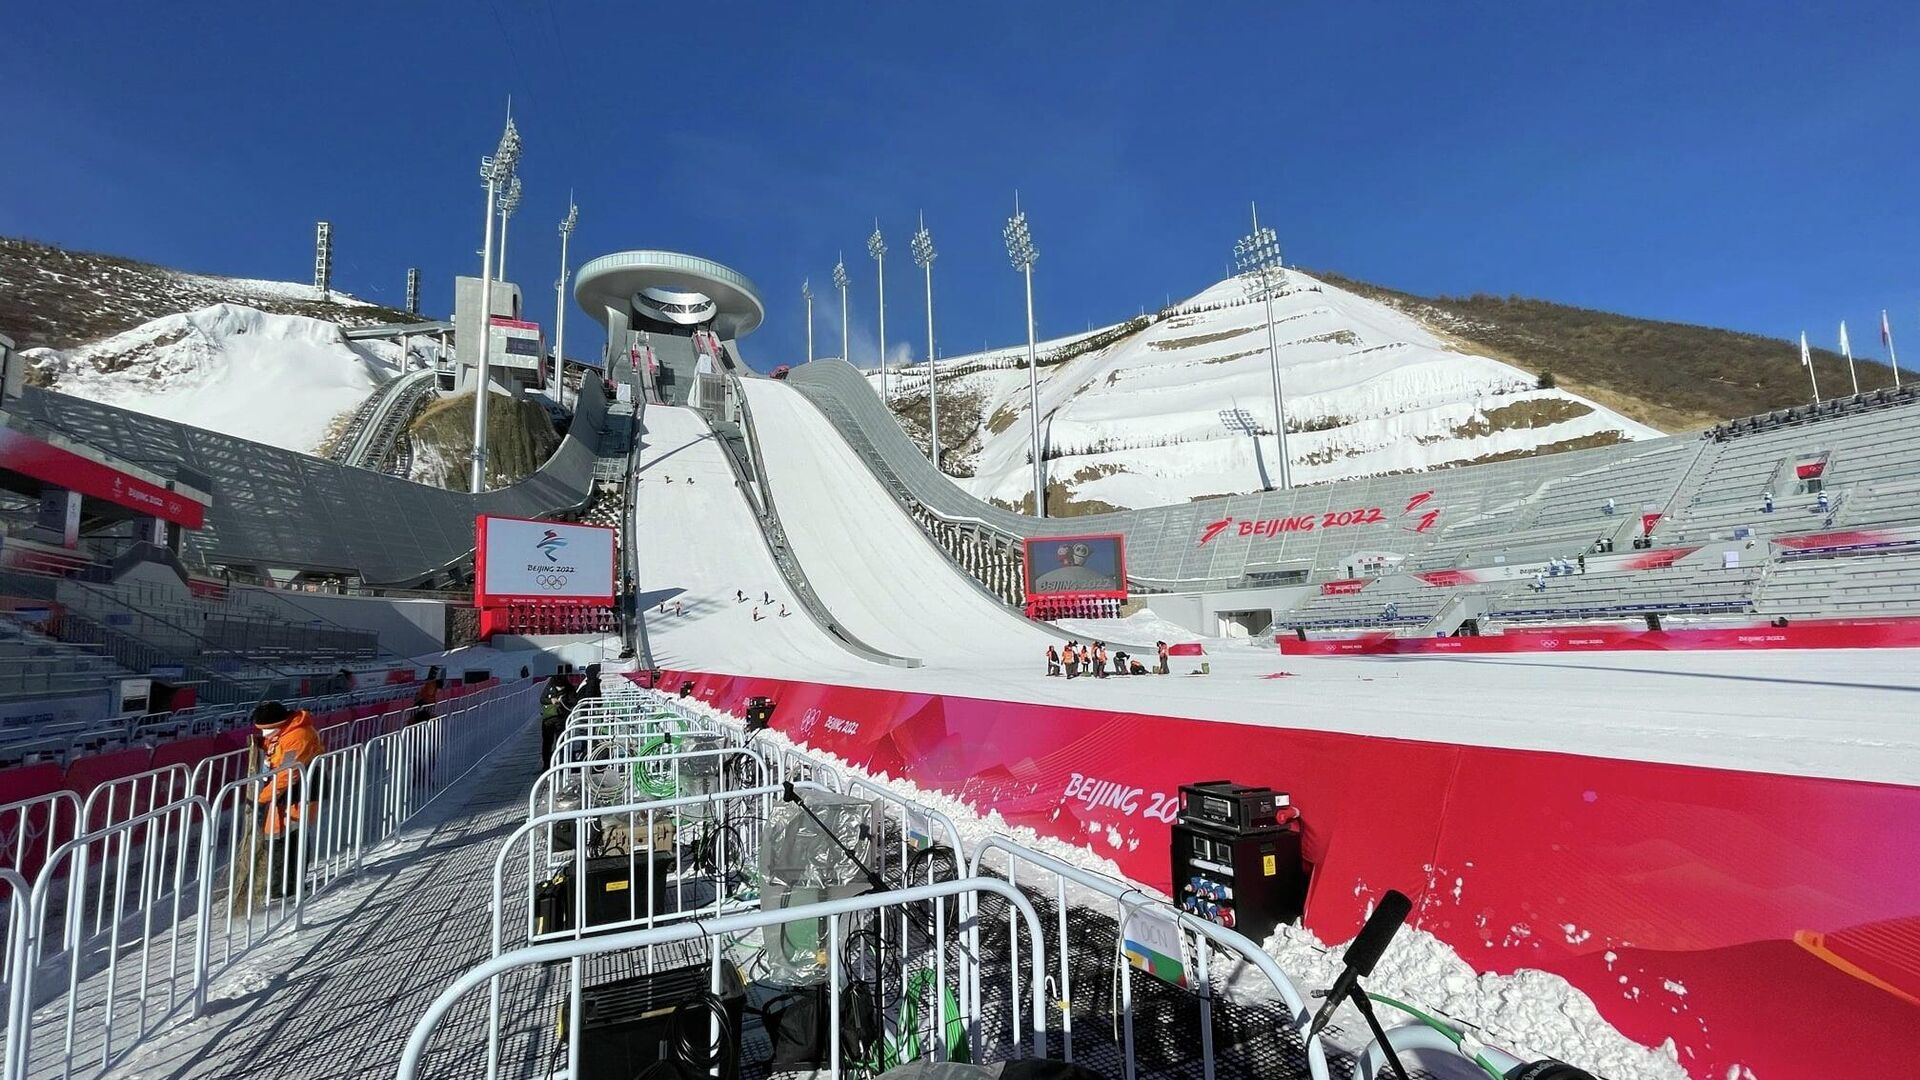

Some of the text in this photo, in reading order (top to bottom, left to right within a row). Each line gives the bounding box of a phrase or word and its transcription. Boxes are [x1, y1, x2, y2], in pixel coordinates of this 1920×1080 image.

[1238, 508, 1387, 537] BEIJING 2022
[527, 564, 554, 573] BEIJING
[824, 716, 844, 732] BEIJING
[1064, 773, 1143, 816] BEIJING
